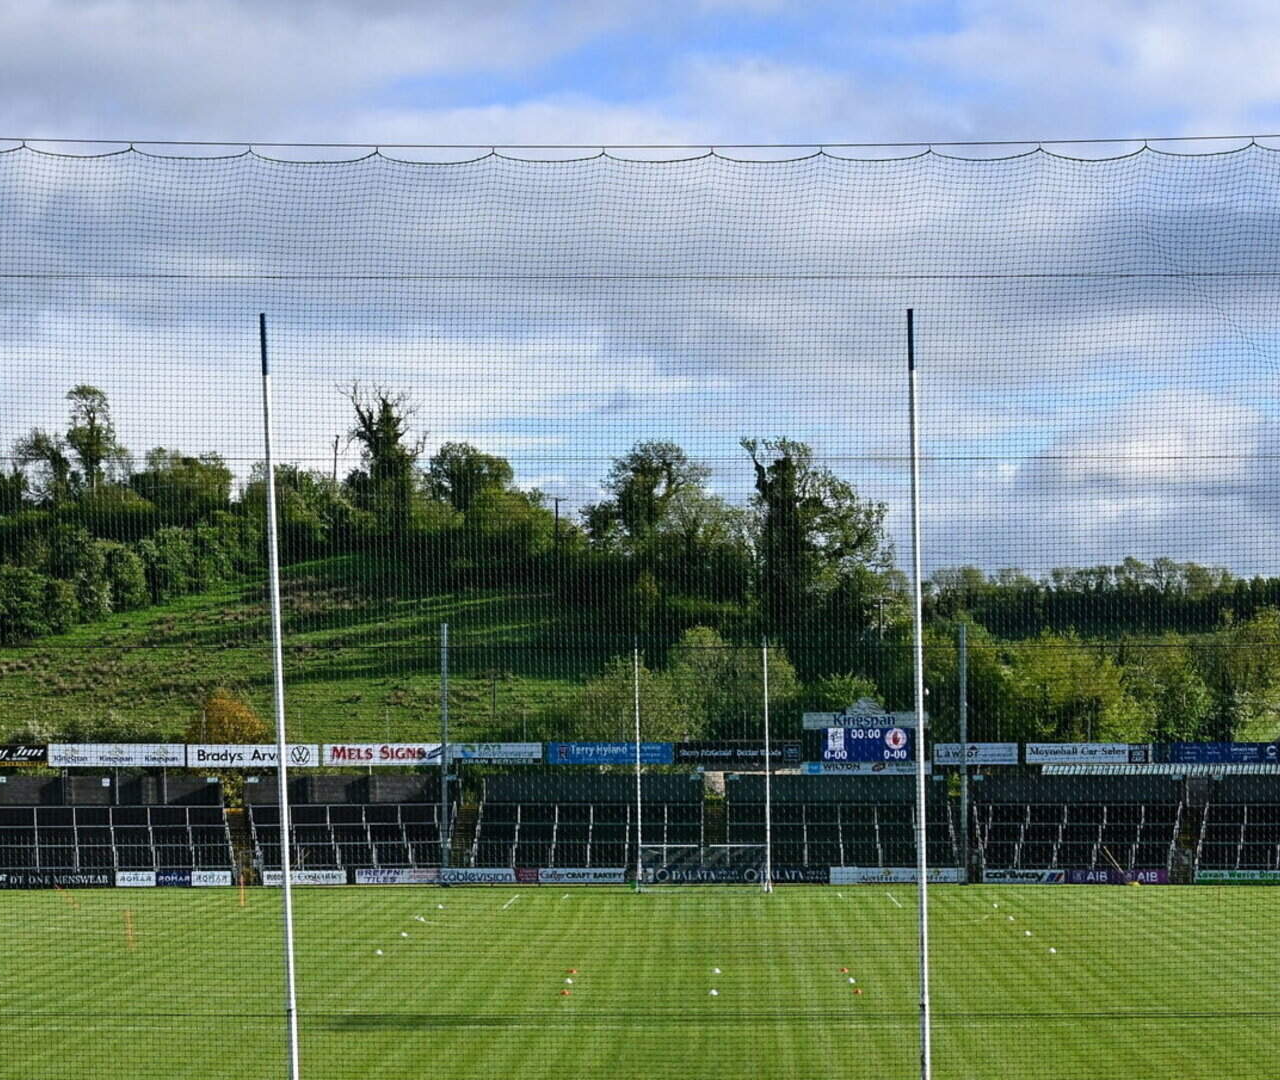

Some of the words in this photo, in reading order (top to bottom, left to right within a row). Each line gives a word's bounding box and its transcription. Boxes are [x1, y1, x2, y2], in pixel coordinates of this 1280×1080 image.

[833, 714, 895, 728] Kingspan
[13, 746, 44, 757] Inn
[331, 746, 373, 760] MELS
[379, 746, 425, 760] SIGNS
[571, 745, 595, 757] Terry
[596, 744, 627, 757] Hyland
[824, 751, 847, 759] 0-00
[884, 750, 907, 759] 0-00
[936, 749, 980, 758] Lawor
[197, 750, 244, 763] Bradys
[823, 762, 860, 771] WILTON
[442, 870, 513, 881] cablevision
[1087, 871, 1108, 881] AIB
[1137, 871, 1158, 882] AIB
